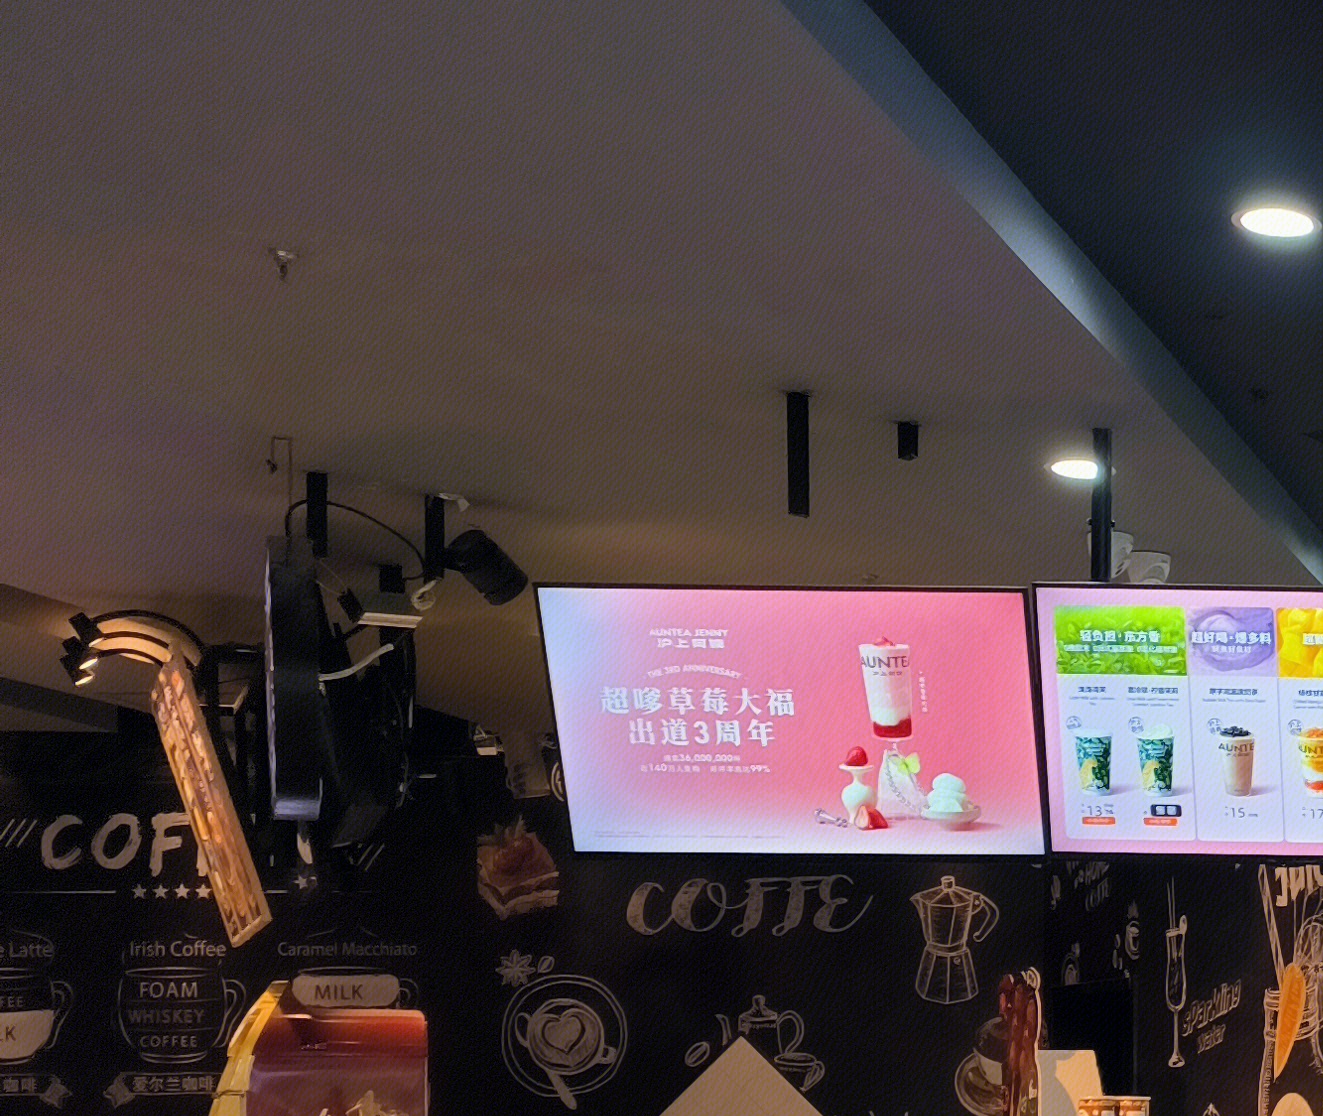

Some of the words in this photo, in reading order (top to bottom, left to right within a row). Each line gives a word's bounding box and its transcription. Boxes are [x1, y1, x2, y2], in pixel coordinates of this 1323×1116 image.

[629, 718, 776, 747] 出道3周年
[40, 812, 210, 878] COF
[130, 941, 166, 957] Irish
[170, 941, 227, 957] Coffee
[277, 942, 337, 957] Caramel
[341, 942, 418, 957] Macchiato
[139, 982, 199, 998] FOAM
[314, 984, 364, 1000] MILK
[128, 1009, 205, 1024] WHISKEY
[139, 1035, 199, 1049] COFFEE
